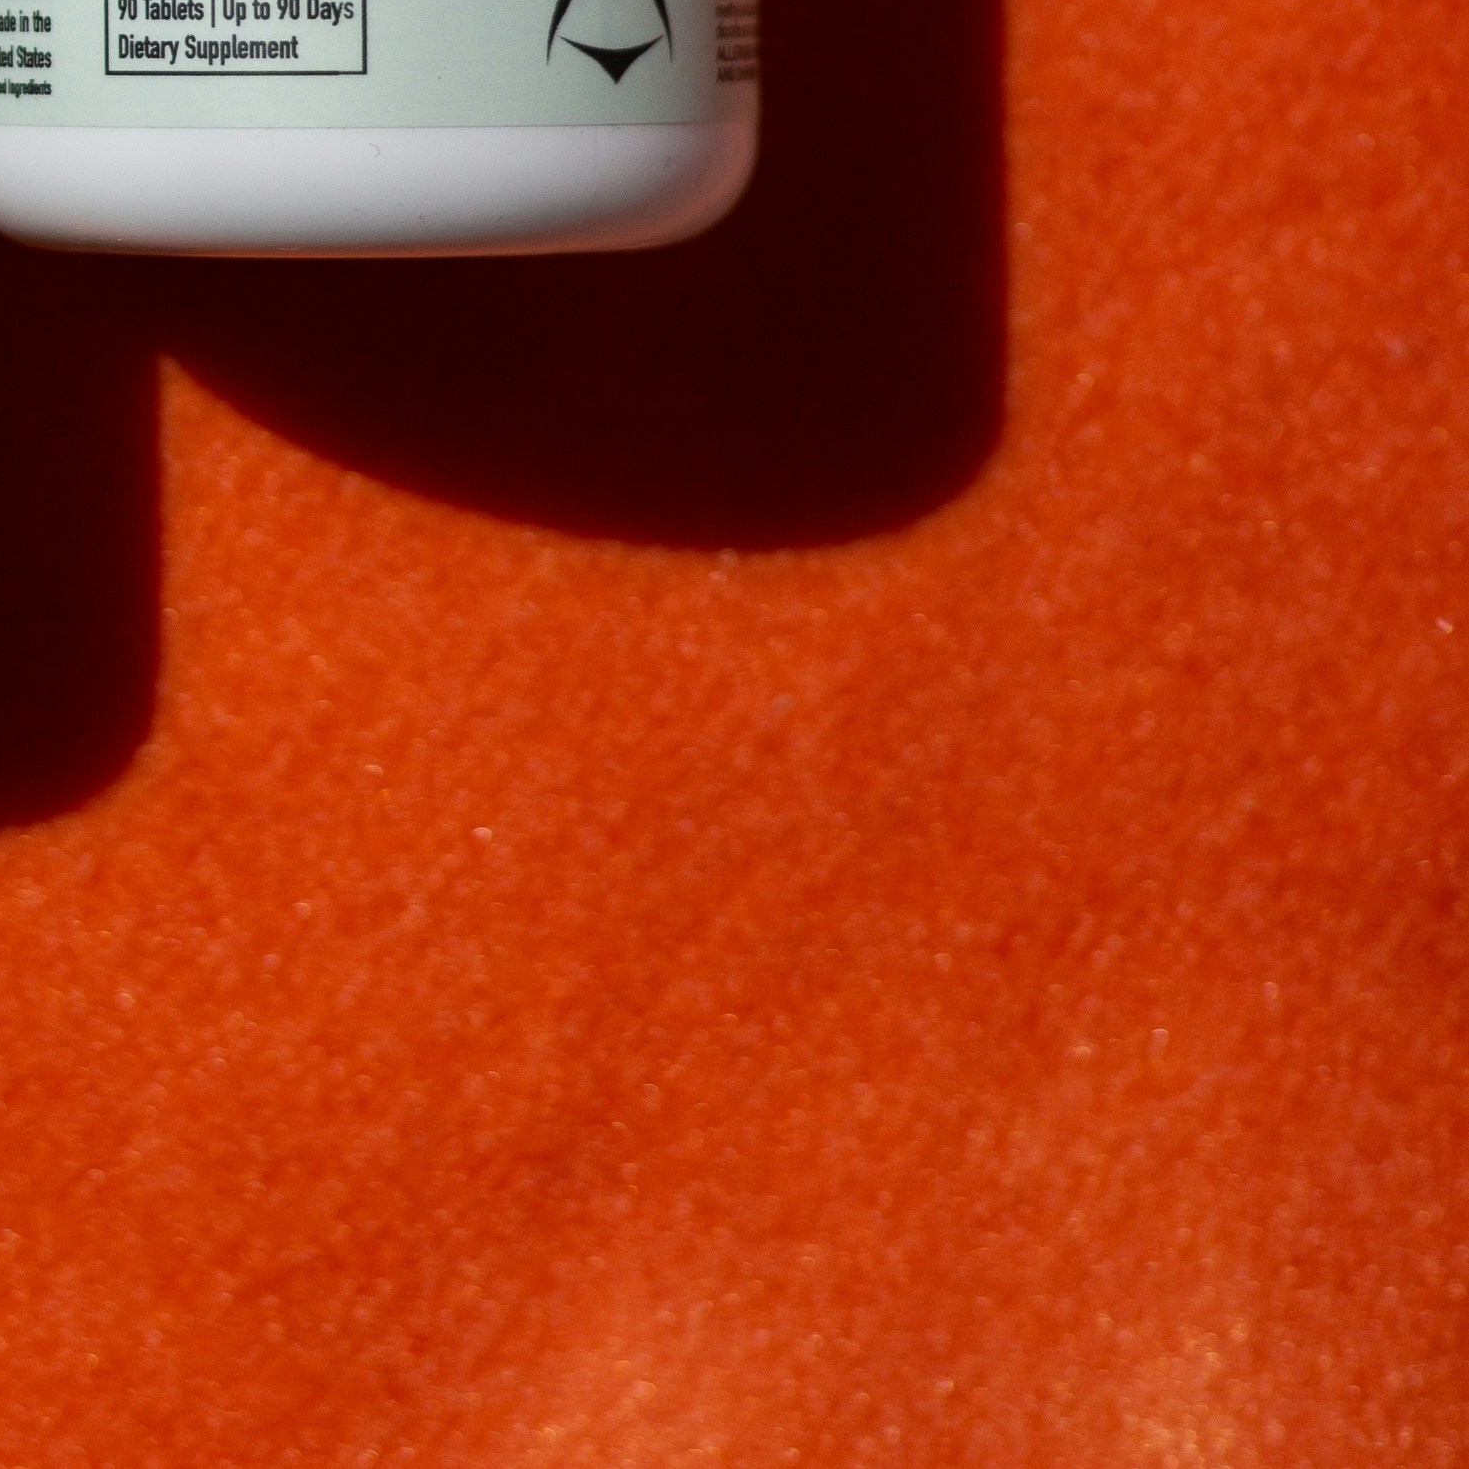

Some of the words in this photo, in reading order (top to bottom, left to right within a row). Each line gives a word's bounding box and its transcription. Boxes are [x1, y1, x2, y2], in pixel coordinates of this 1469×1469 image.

[19, 10, 30, 33] in
[32, 10, 52, 33] the
[16, 45, 52, 69] States
[118, 33, 180, 66] Dietary
[184, 33, 299, 66] Supplement
